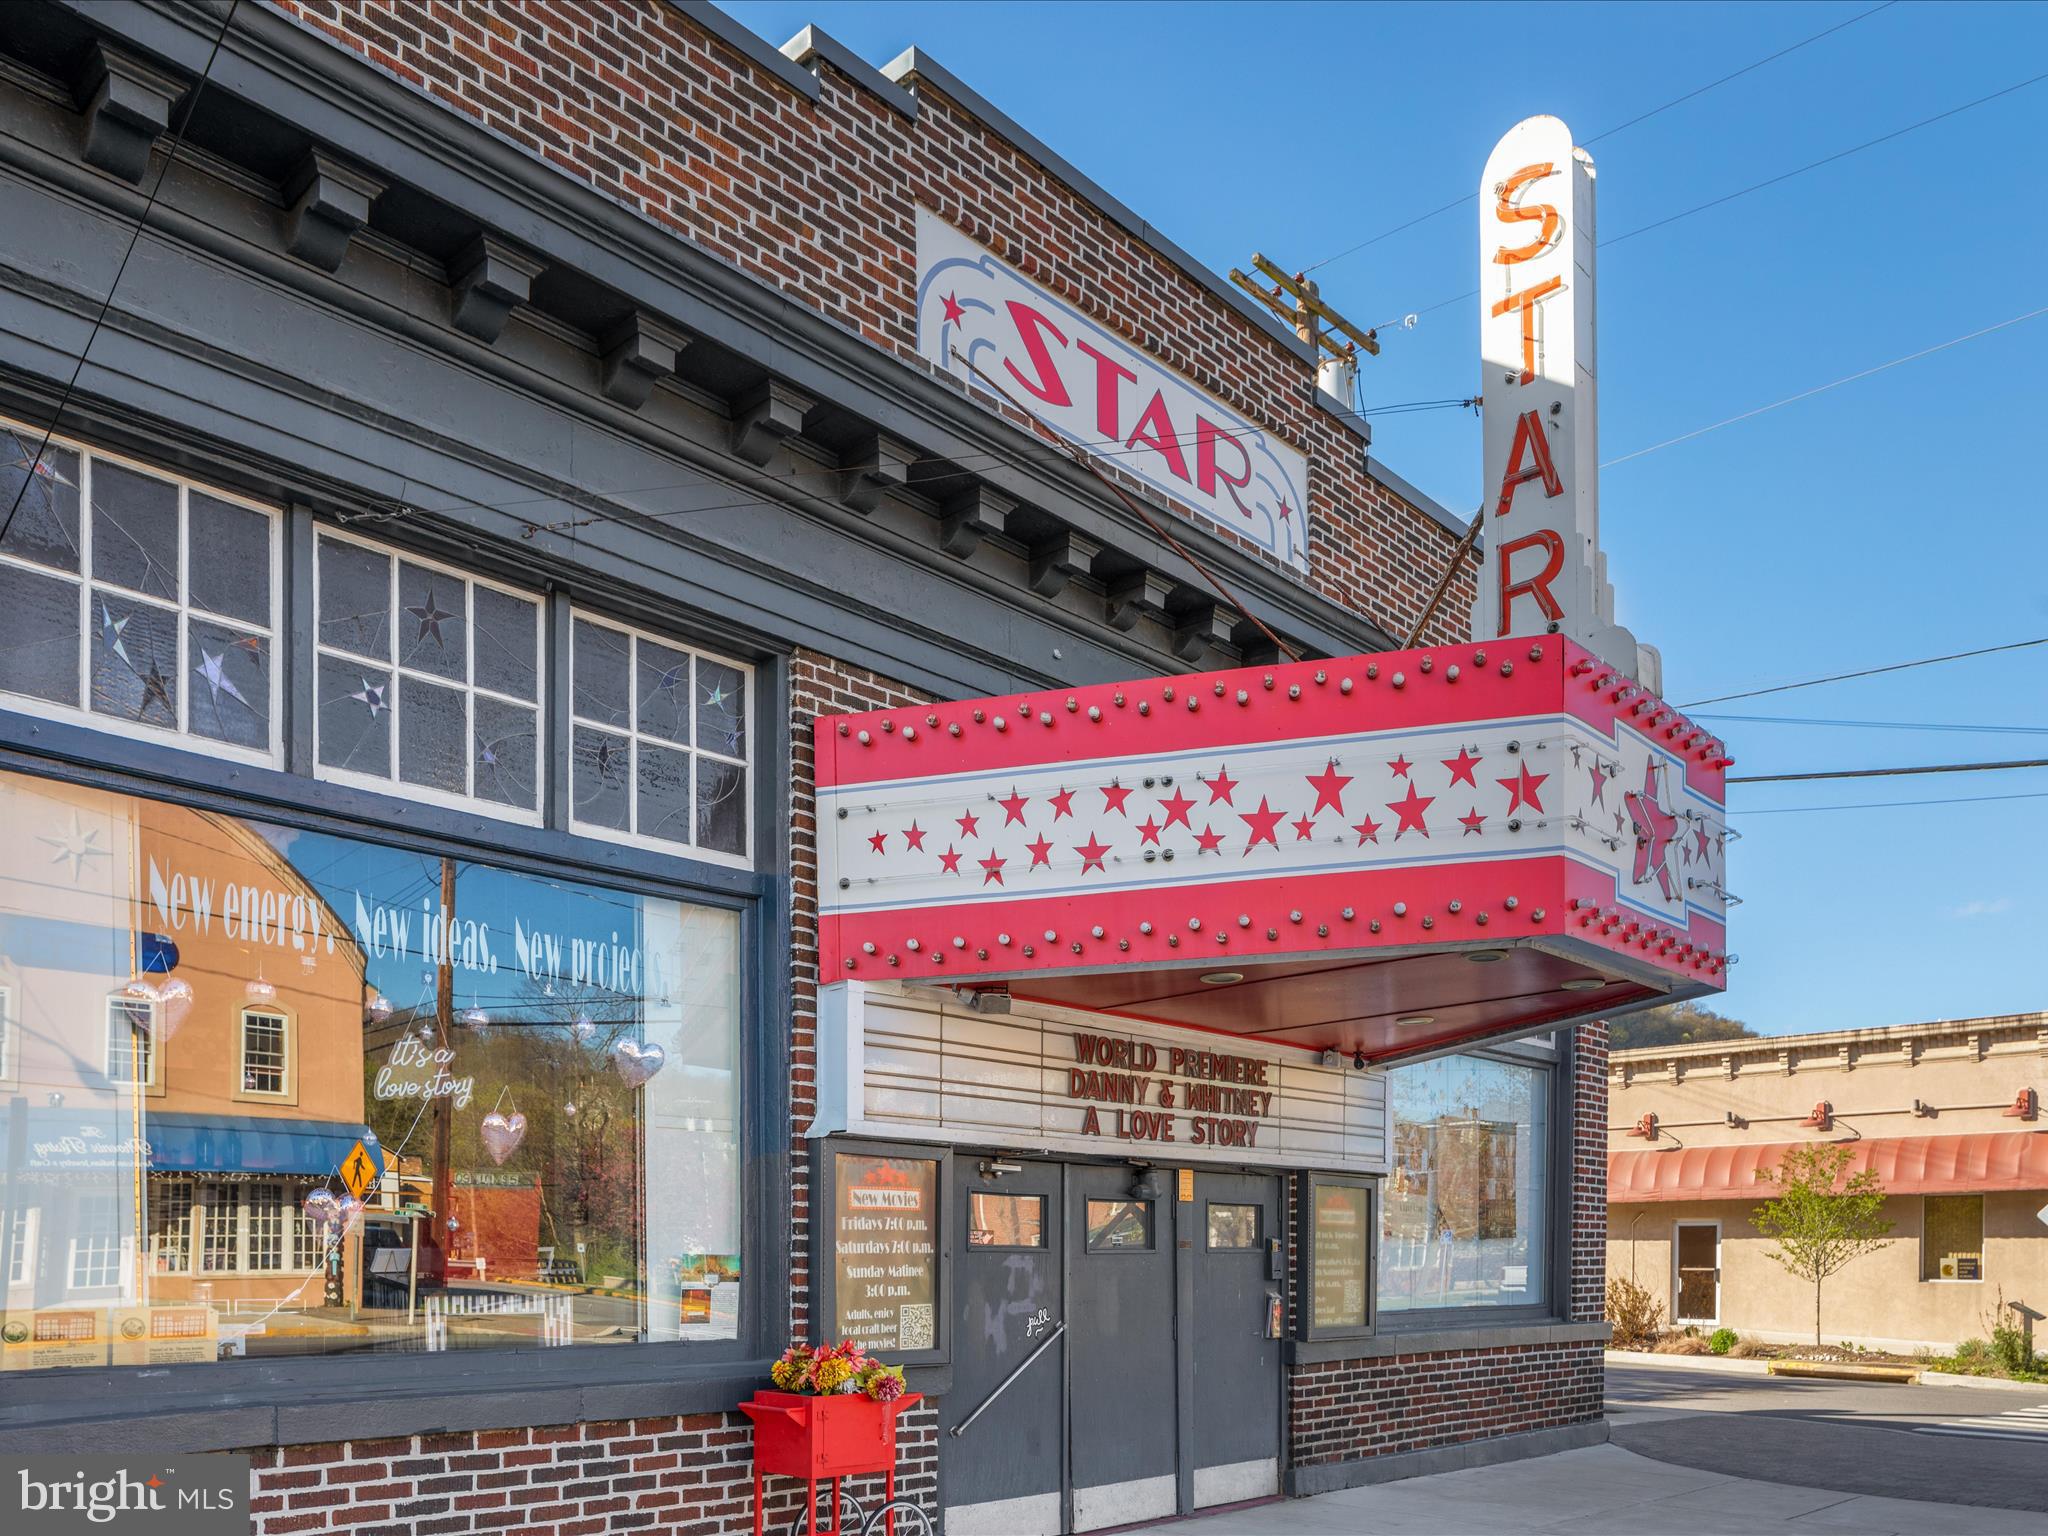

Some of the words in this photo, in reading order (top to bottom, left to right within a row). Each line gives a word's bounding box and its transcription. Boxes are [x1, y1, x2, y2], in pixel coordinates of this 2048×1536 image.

[1003, 299, 1252, 519] STAR
[1491, 161, 1567, 637] STAR
[149, 852, 215, 936] New
[223, 883, 336, 955] energy.
[355, 889, 412, 963] New
[423, 897, 498, 975] ideas.
[516, 916, 564, 982] New
[434, 1048, 455, 1063] a
[1074, 1032, 1157, 1072] WORLD
[1169, 1047, 1269, 1087] PREMIERE
[377, 1067, 421, 1098] love
[422, 1067, 473, 1108] story
[1068, 1068, 1151, 1105] DANNY
[1160, 1079, 1175, 1109] &
[1184, 1082, 1273, 1118] WHITNEY
[1082, 1105, 1101, 1136] A
[1116, 1109, 1176, 1142] LOVE
[1191, 1116, 1259, 1148] STORY
[852, 1191, 879, 1207] New
[882, 1191, 919, 1208] Movies
[841, 1216, 883, 1232] Fridays
[884, 1217, 906, 1231] 7:00
[906, 1220, 928, 1231] p.m.
[836, 1240, 890, 1255] Saturdays
[891, 1241, 911, 1254] 7:00
[912, 1243, 934, 1255] p.m.
[846, 1264, 885, 1279] Sunday
[887, 1263, 924, 1278] Matinee
[865, 1284, 885, 1298] 3:00
[888, 1285, 911, 1298] p.m.
[841, 1325, 861, 1336] local
[1026, 1307, 1051, 1337] pull
[857, 1340, 867, 1350] he
